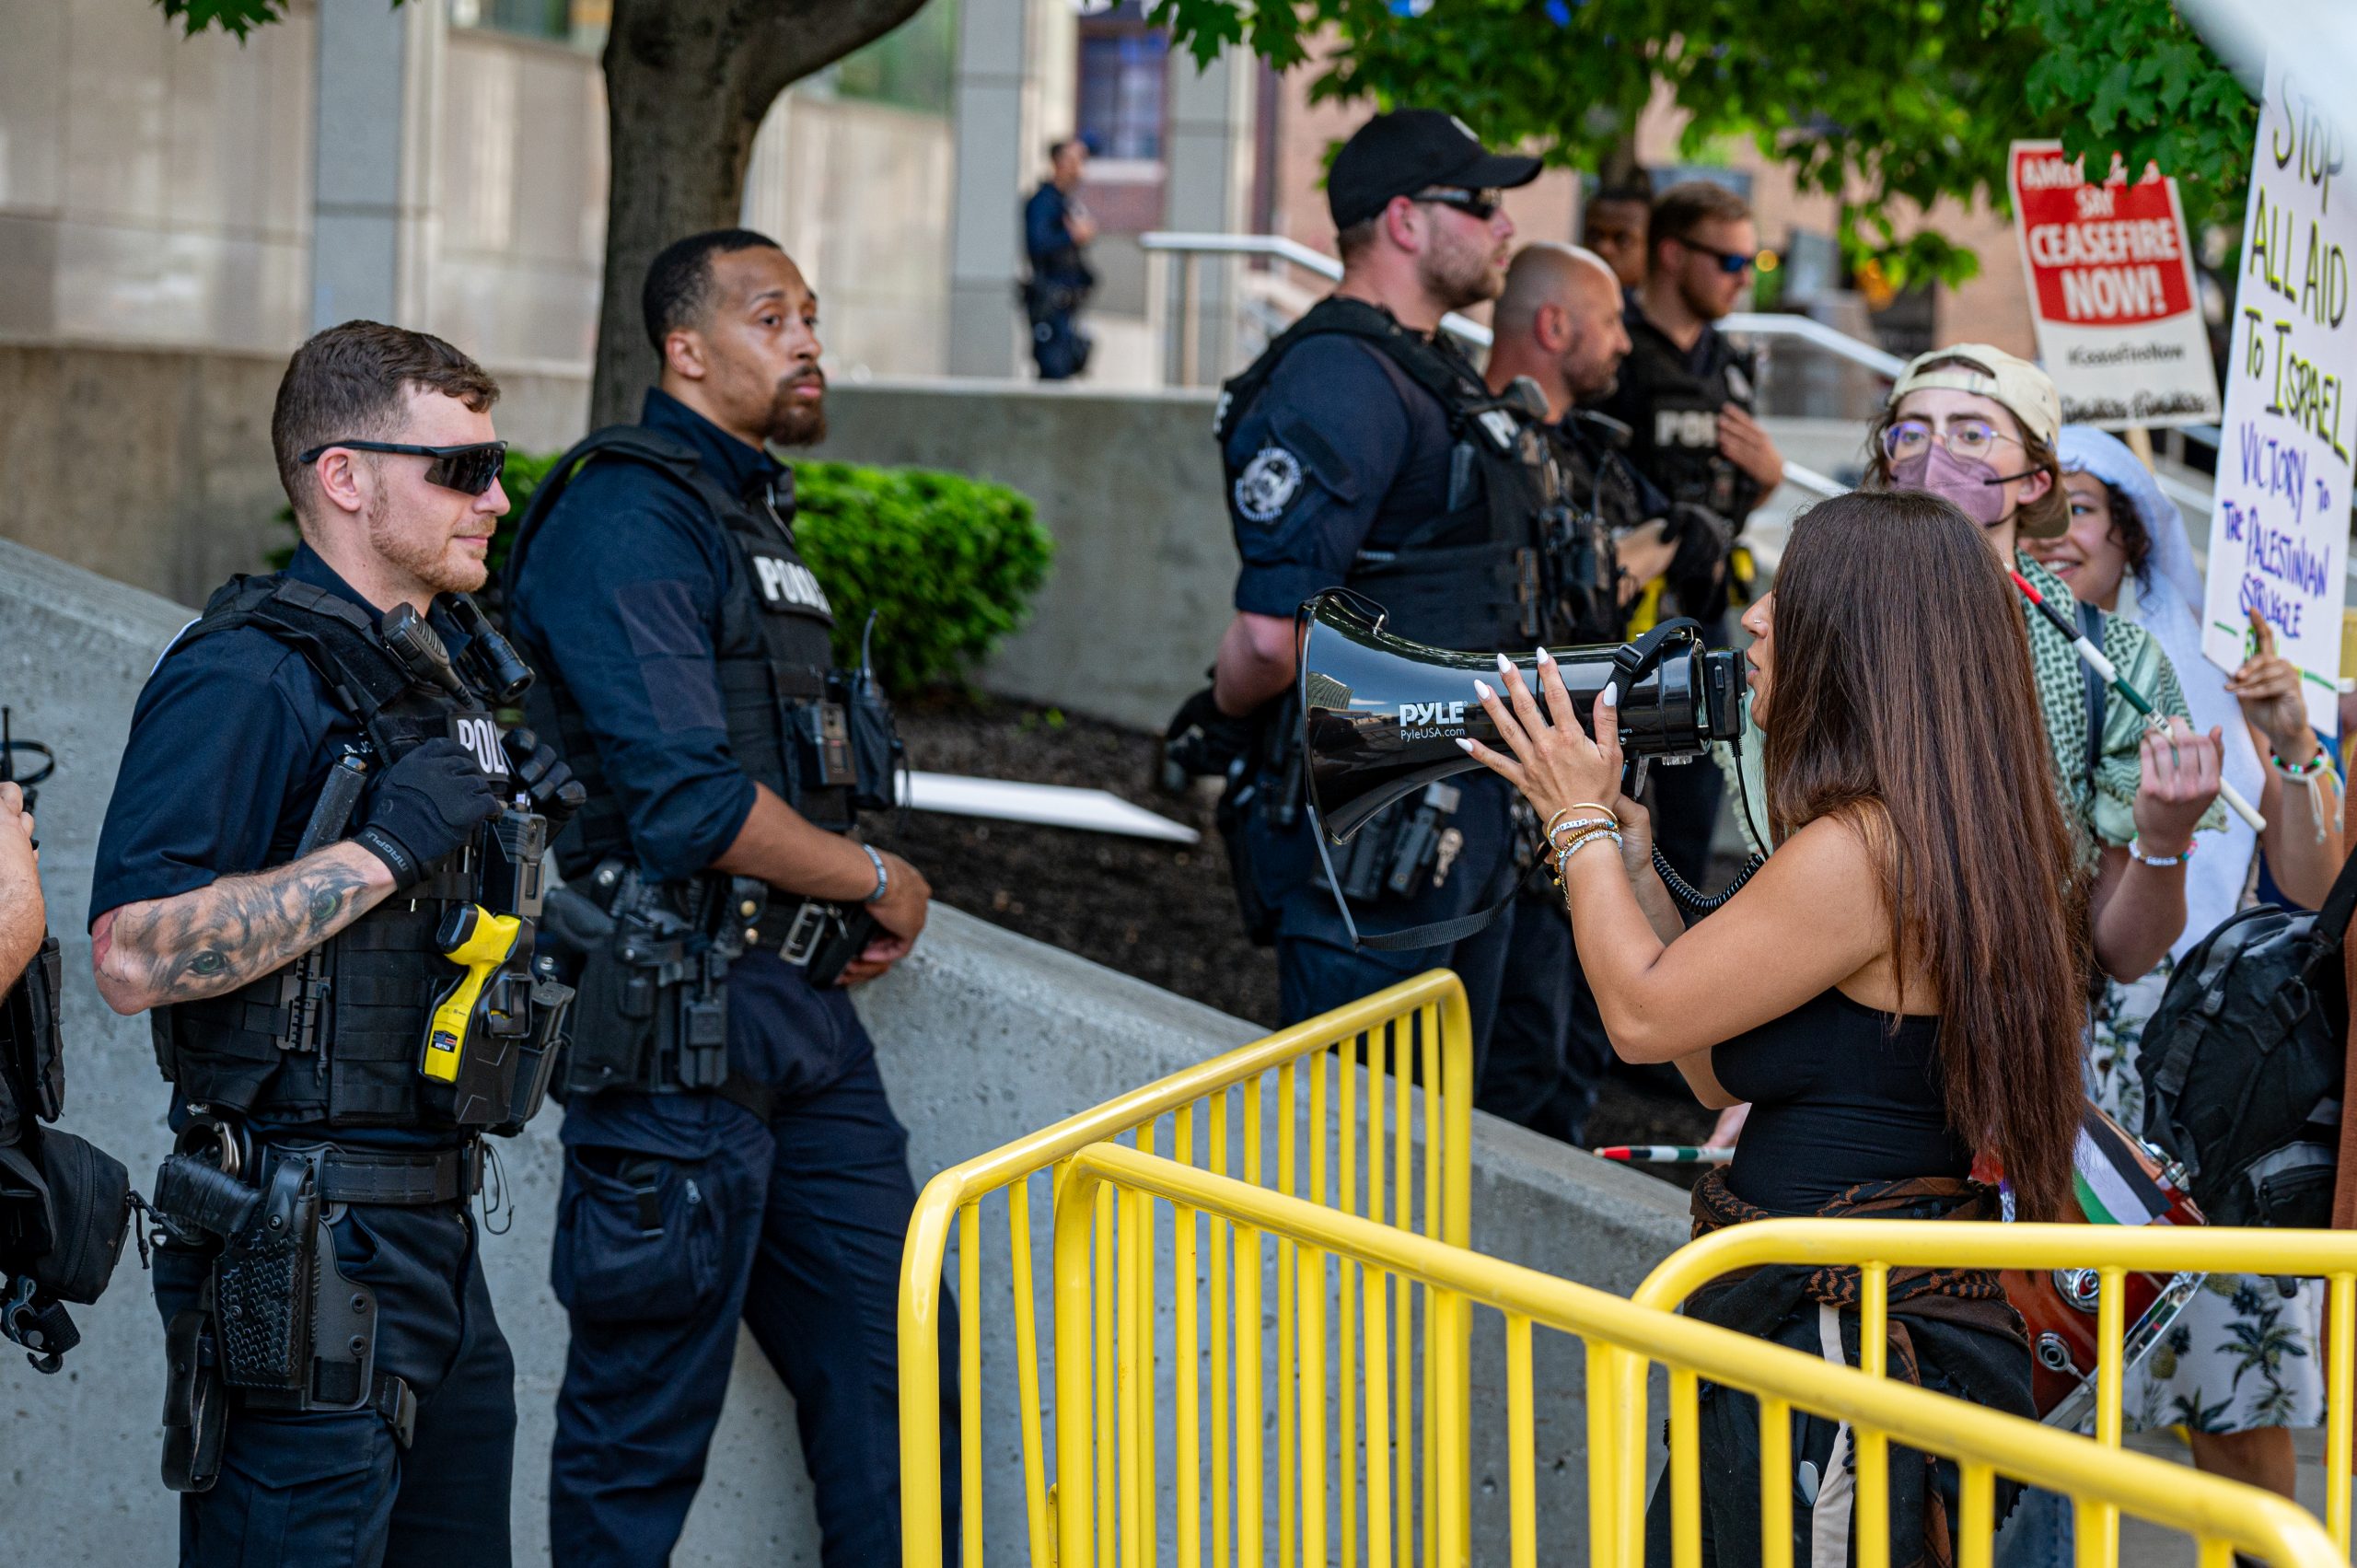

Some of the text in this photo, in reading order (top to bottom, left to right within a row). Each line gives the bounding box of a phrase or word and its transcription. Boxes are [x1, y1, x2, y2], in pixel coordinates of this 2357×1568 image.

[2074, 188, 2116, 219] SAY
[2028, 217, 2180, 268] CEASEFIRE
[2249, 184, 2348, 330] ALL AID
[2061, 265, 2167, 320] NOW!
[2266, 319, 2350, 464] ISRAEL
[2240, 421, 2307, 525] VICTORY
[2246, 505, 2330, 598] PALESTINIAN
[1399, 701, 1465, 727] PYLE
[1400, 727, 1466, 742] PyleUSA.com
